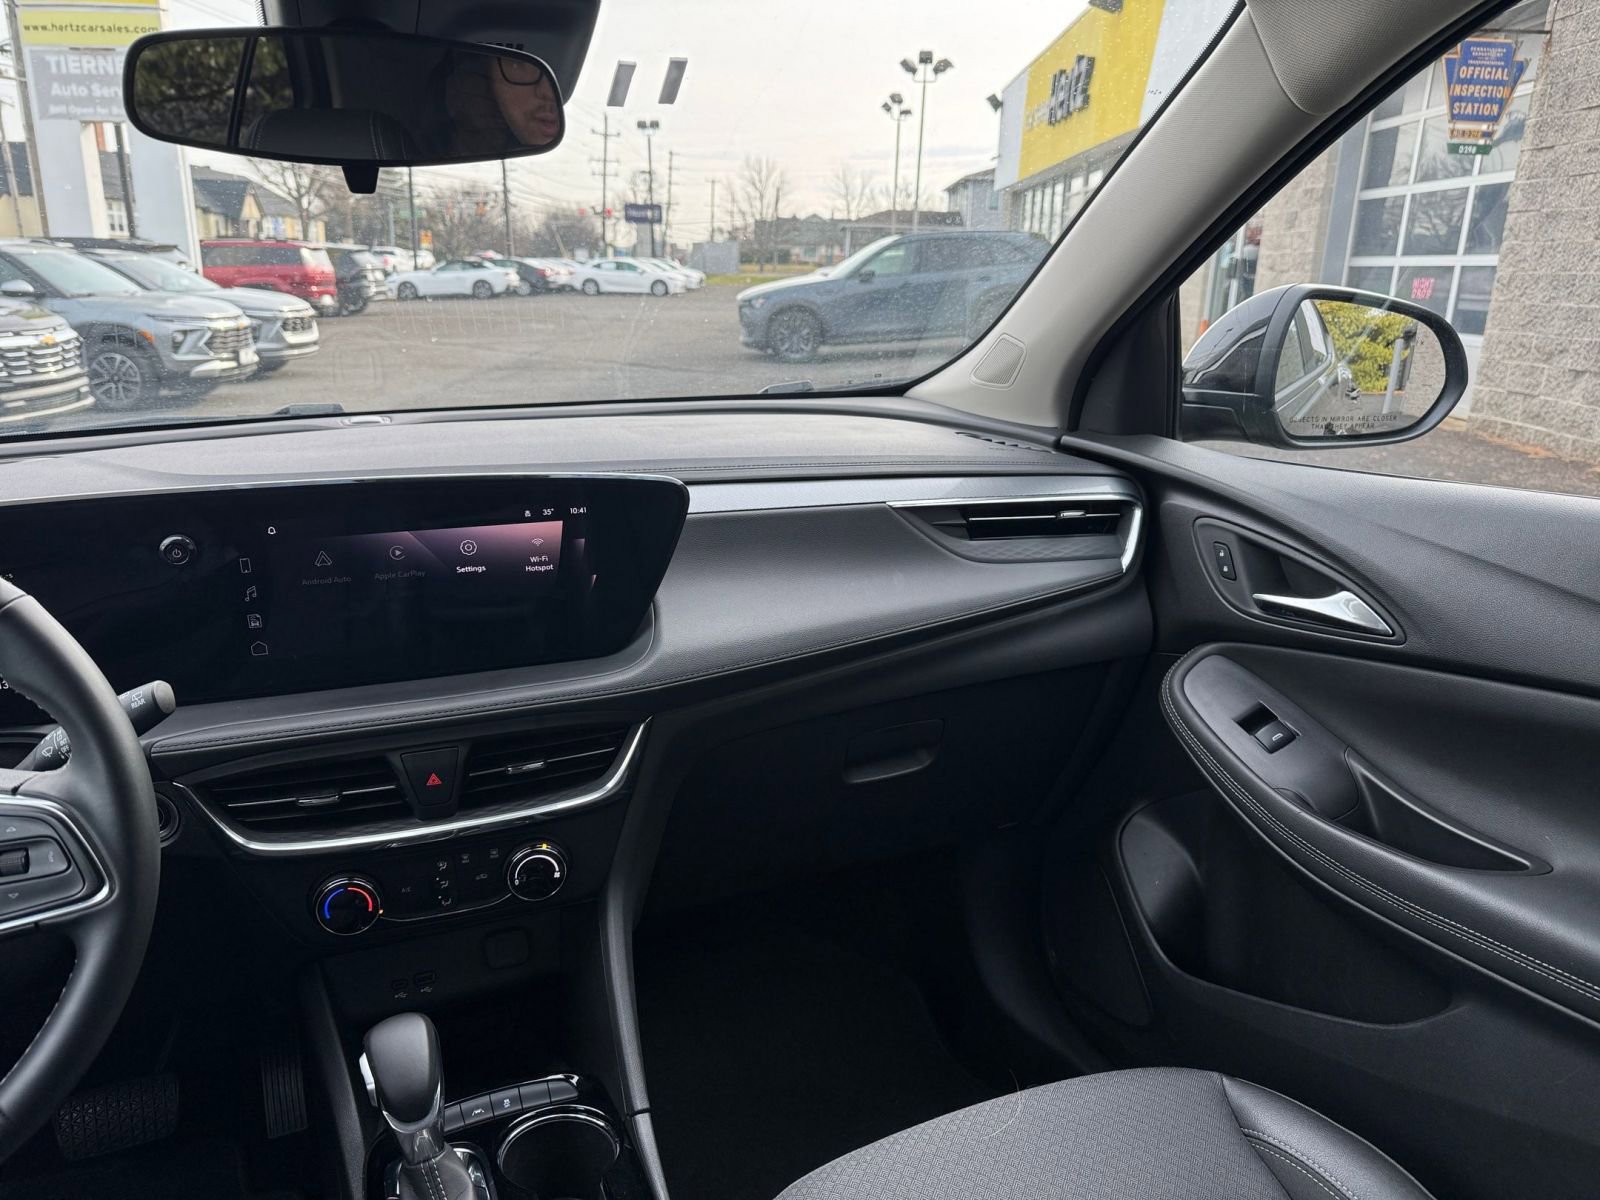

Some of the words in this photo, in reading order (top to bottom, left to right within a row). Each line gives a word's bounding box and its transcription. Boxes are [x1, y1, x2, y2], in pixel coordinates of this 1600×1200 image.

[23, 24, 159, 34] www.hertzcarsales.com
[44, 54, 123, 75] TIERNE
[1459, 66, 1509, 80] OFFICIAL
[51, 82, 88, 97] Auto
[1449, 85, 1512, 98] INSPECTION
[1453, 102, 1499, 115] STATION
[456, 565, 486, 574] Settings
[525, 564, 554, 572] Hotspot
[302, 577, 332, 585] Android
[374, 572, 396, 581] Apple
[397, 570, 426, 579] CarPlay
[130, 698, 146, 709] REAR
